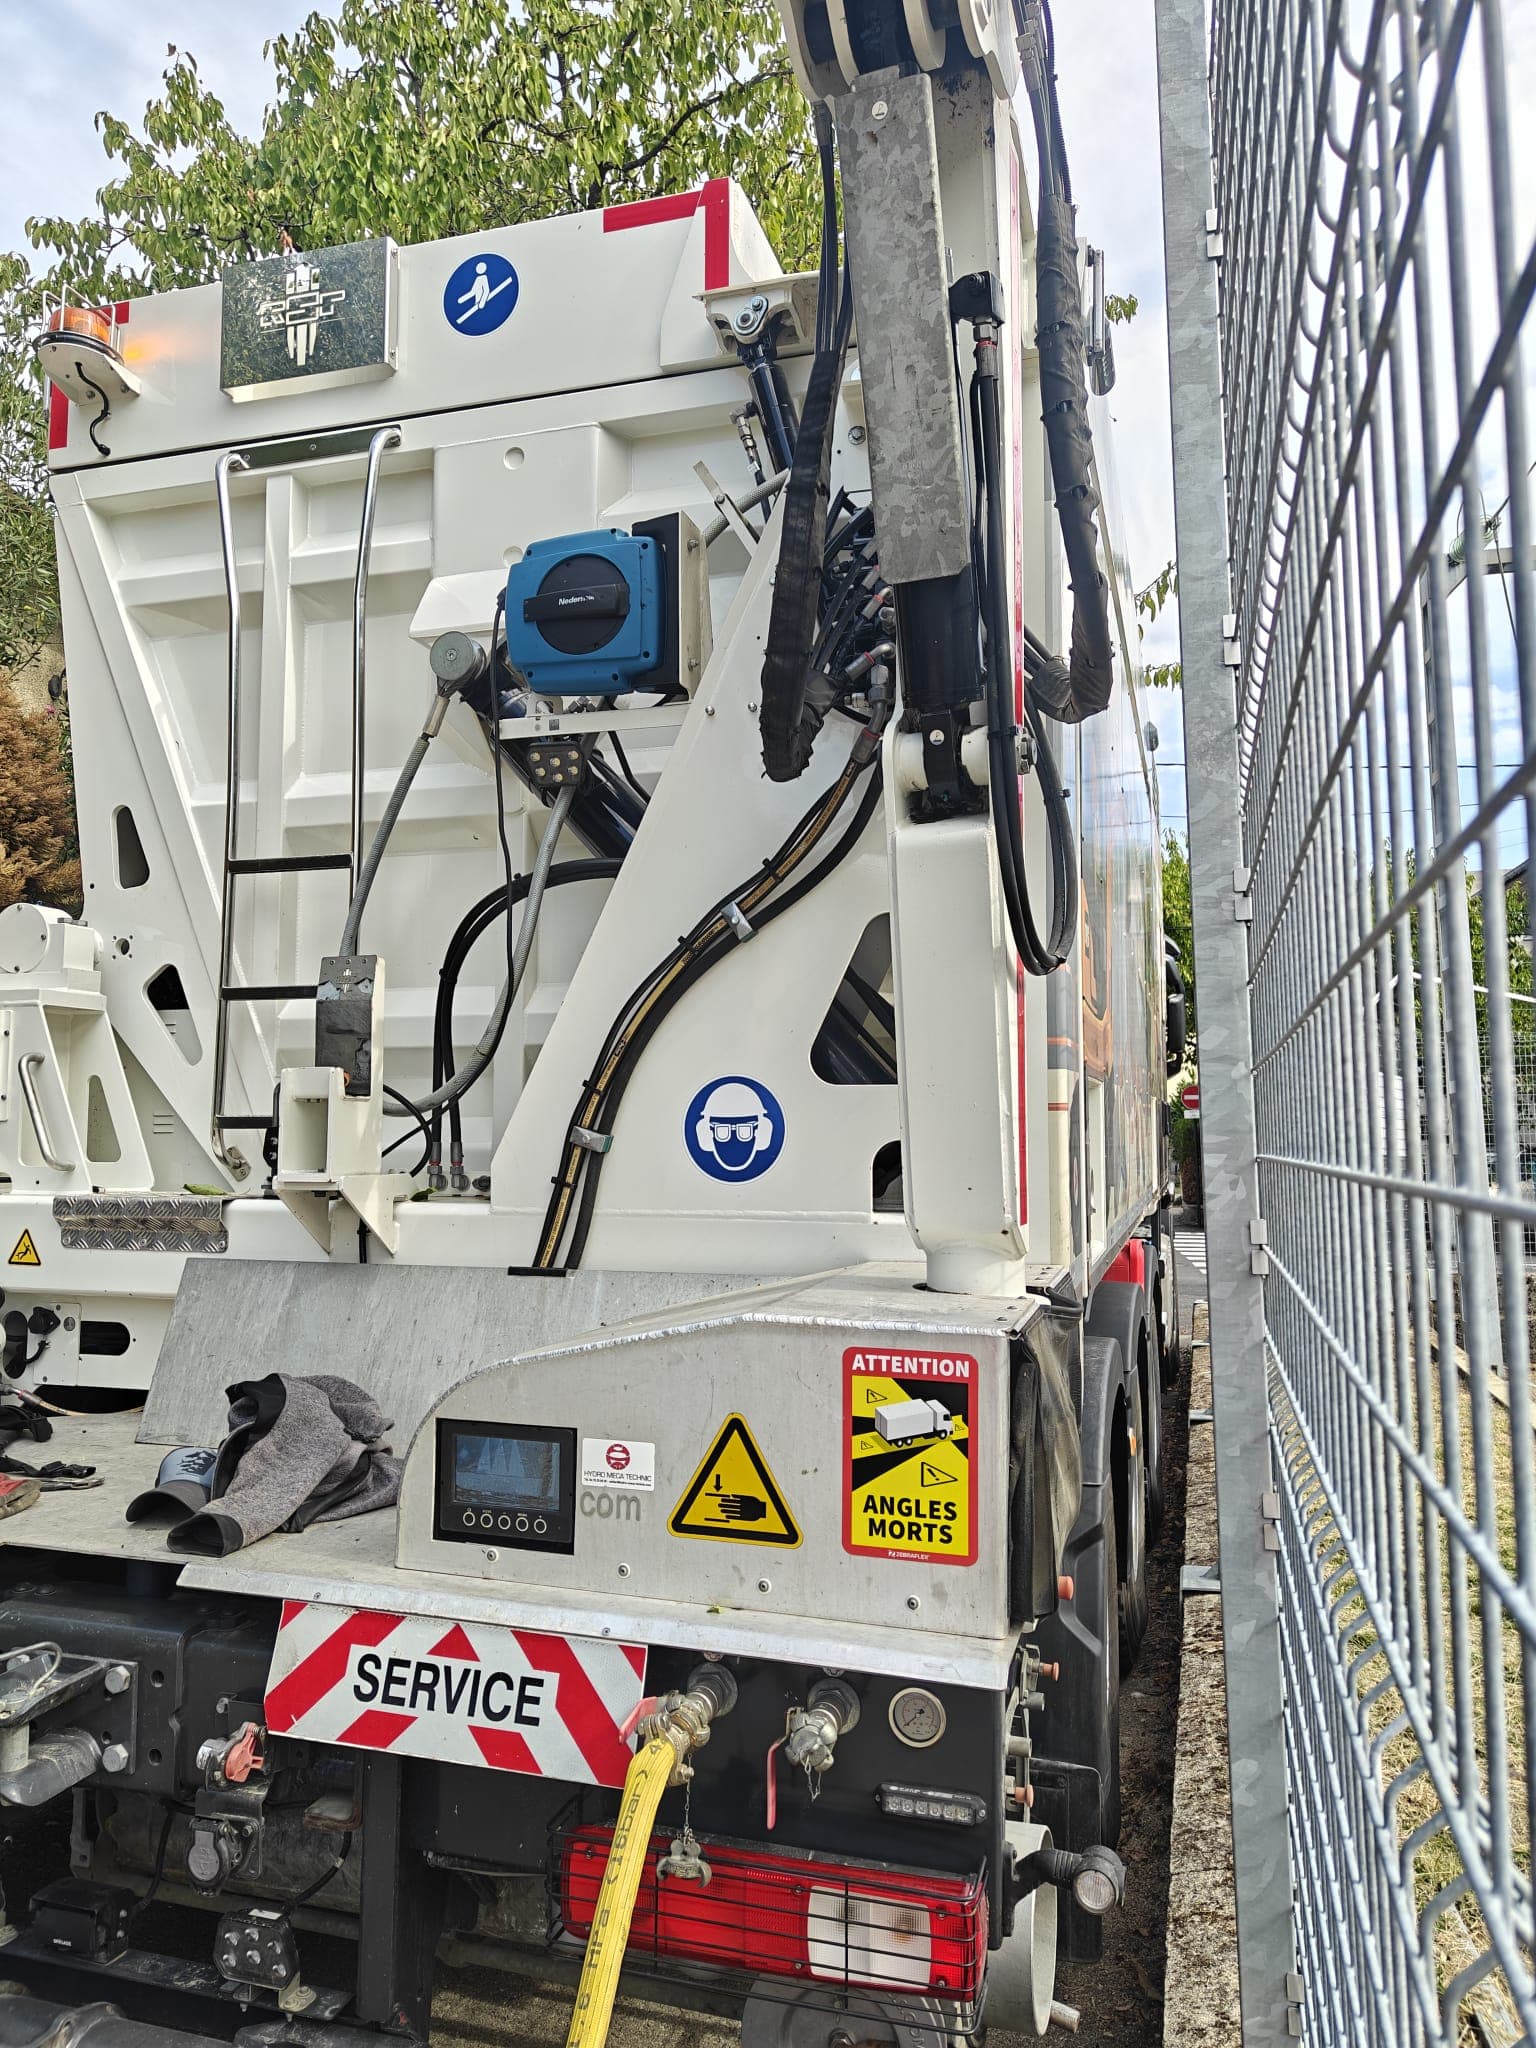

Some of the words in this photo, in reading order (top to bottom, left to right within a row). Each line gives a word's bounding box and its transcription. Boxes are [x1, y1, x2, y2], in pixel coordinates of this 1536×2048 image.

[851, 1354, 970, 1378] ATTENTION
[584, 1470, 605, 1478] HYDRO
[626, 1474, 652, 1482] TECHNIC
[580, 1491, 641, 1521] com
[863, 1494, 958, 1521] ANGLES
[868, 1517, 953, 1544] MORTS
[354, 1653, 545, 1727] SERVICE
